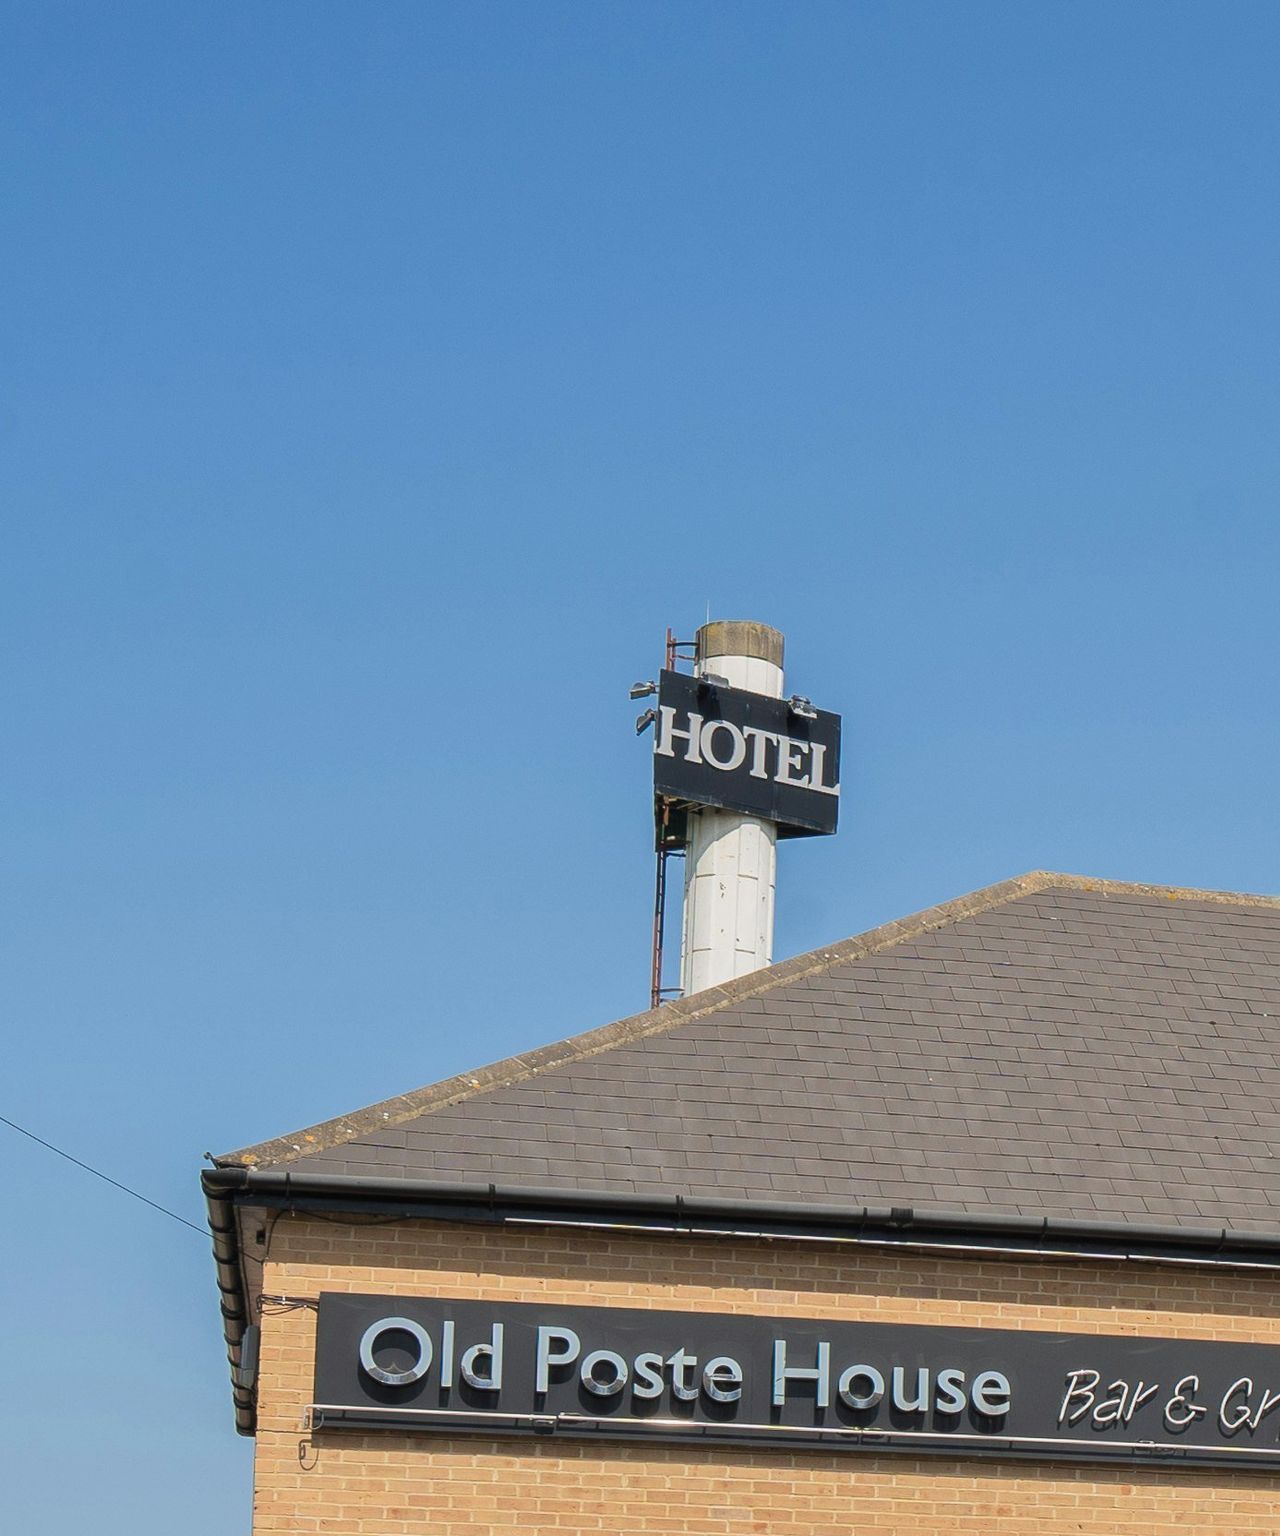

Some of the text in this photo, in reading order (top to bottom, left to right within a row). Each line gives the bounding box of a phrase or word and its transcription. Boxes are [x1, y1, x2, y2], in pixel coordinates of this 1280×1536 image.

[654, 704, 840, 796] HOTEL
[359, 1316, 504, 1391] Old
[536, 1324, 744, 1403] Poste
[772, 1339, 1012, 1417] House
[1057, 1369, 1159, 1424] Bar
[1164, 1374, 1207, 1426] &
